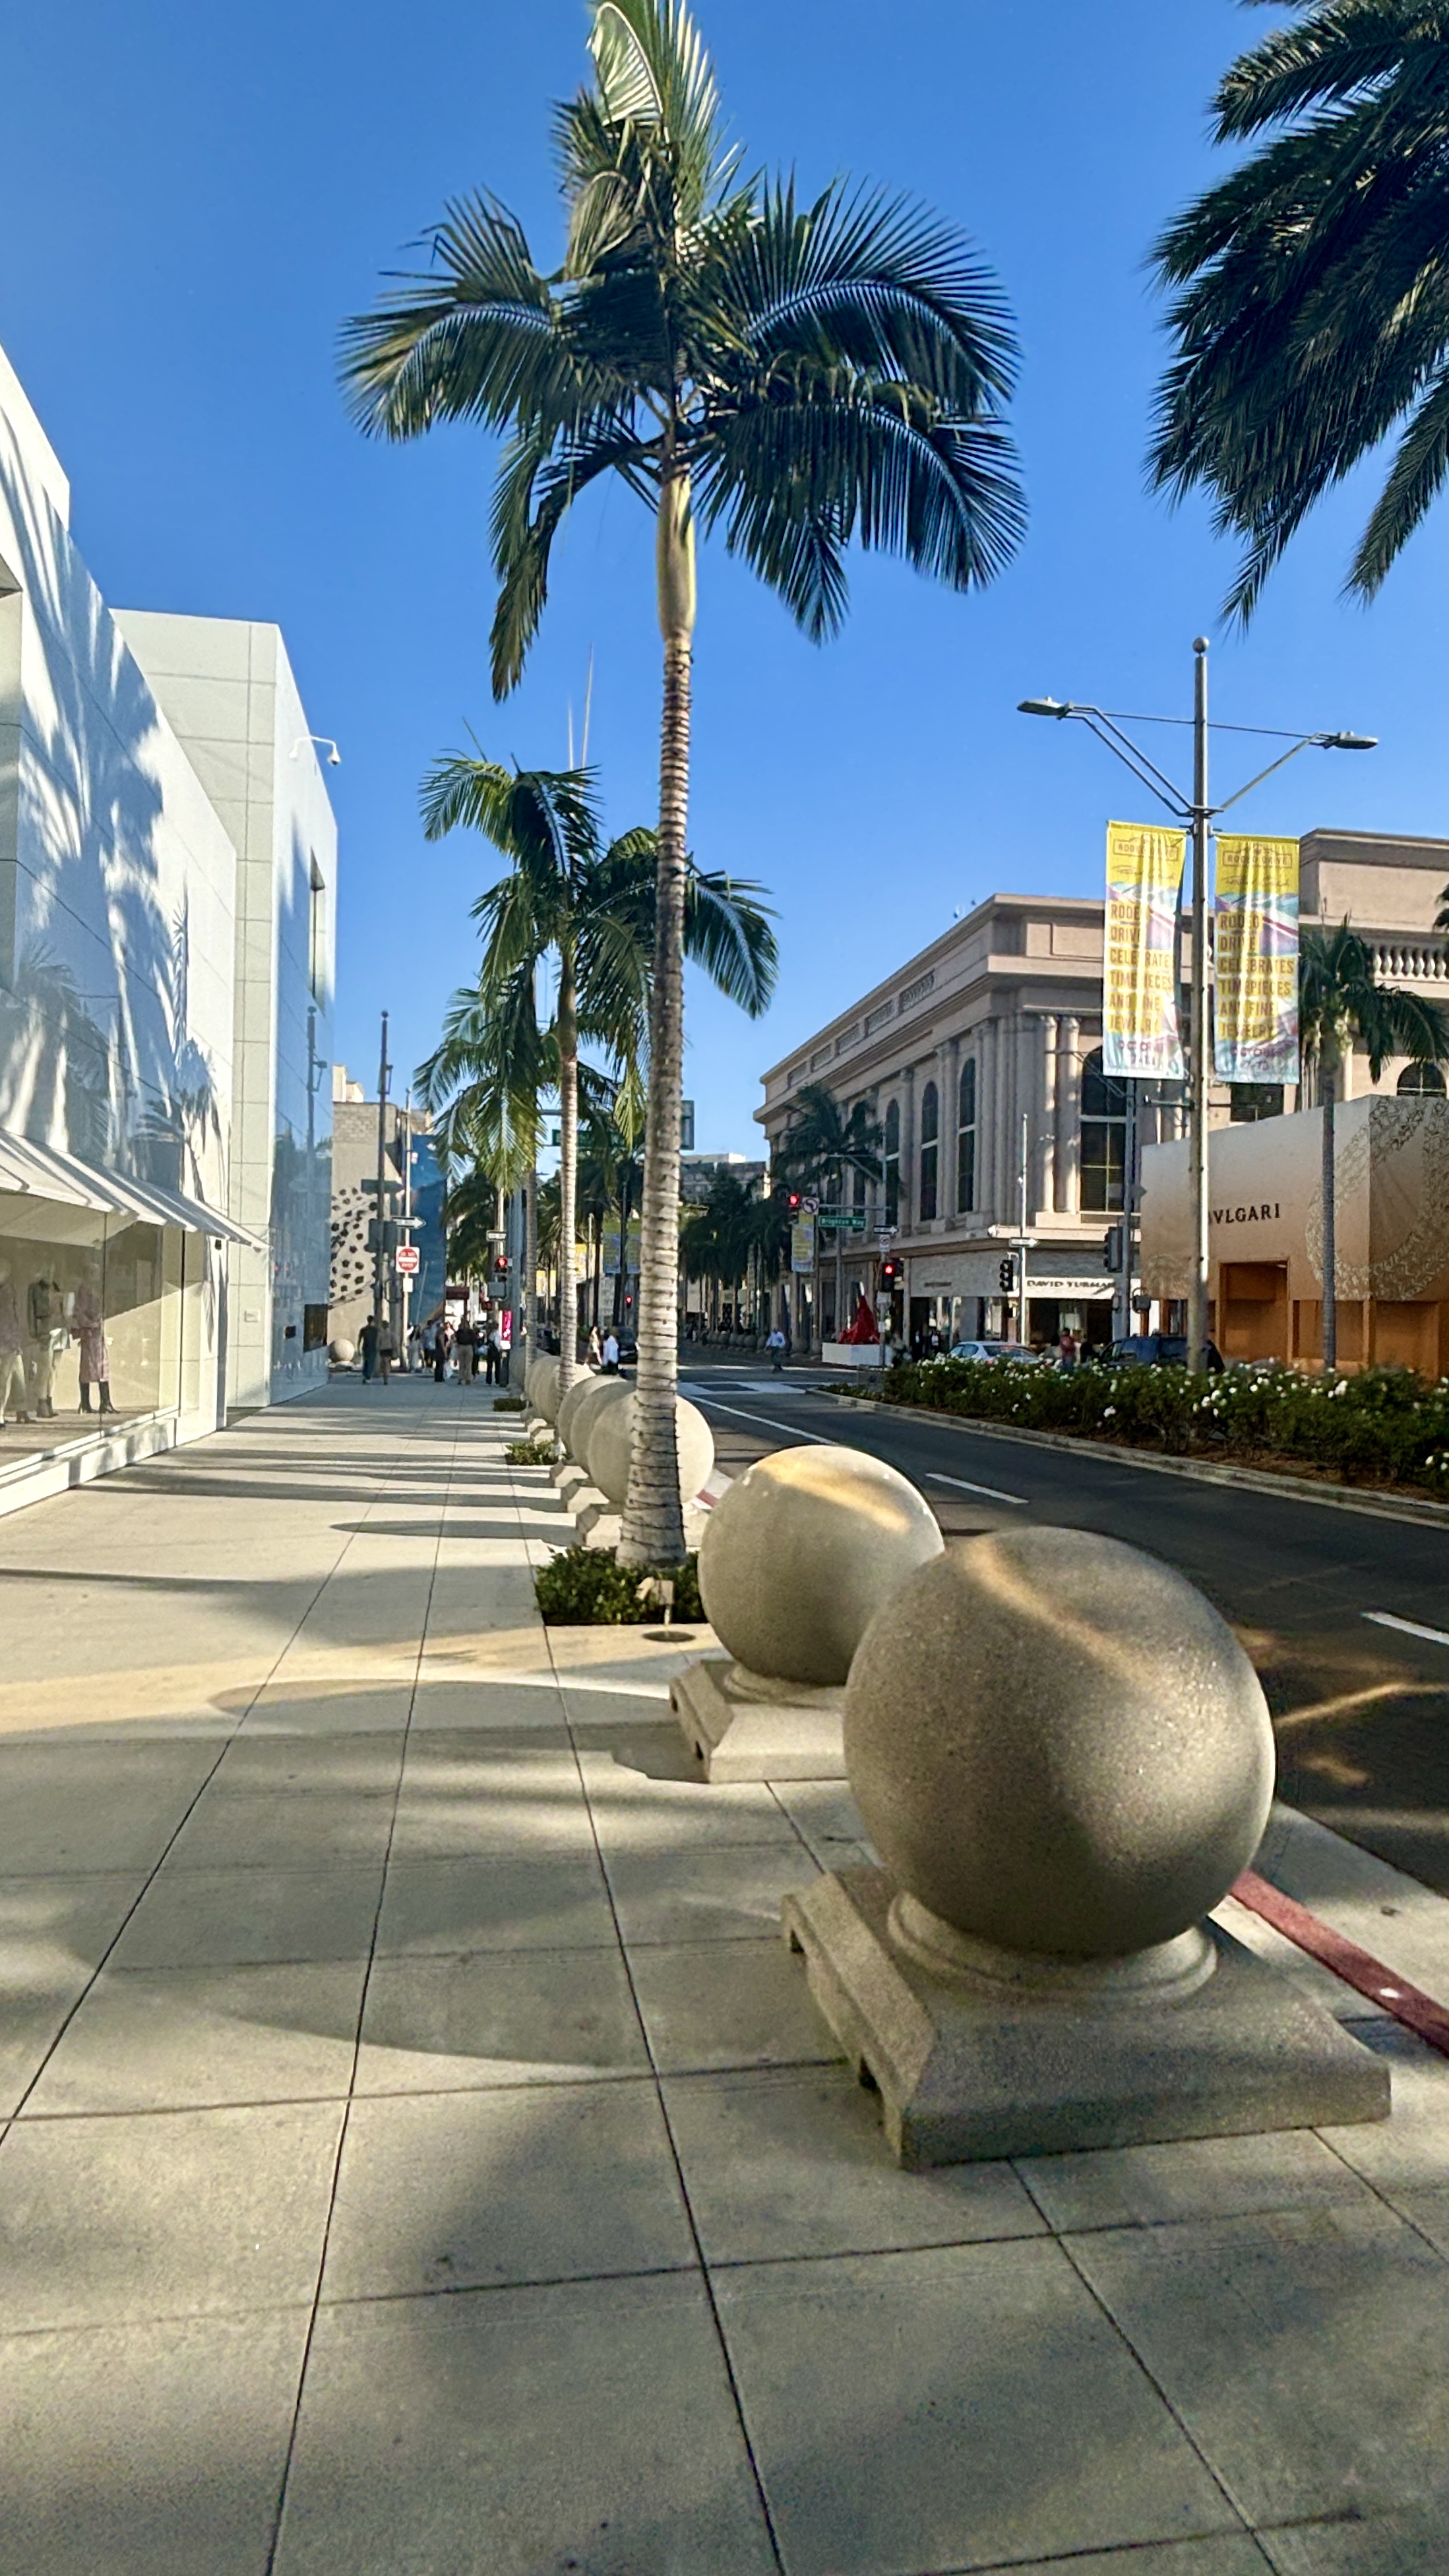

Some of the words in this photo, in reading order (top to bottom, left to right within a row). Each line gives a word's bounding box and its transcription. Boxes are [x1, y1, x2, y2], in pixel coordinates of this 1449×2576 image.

[1227, 854, 1259, 864] RODO
[1111, 903, 1145, 921] RODE
[1110, 926, 1143, 943] DRIV
[1110, 948, 1172, 968] CELERATE
[1110, 970, 1173, 990] TIMEIECES
[1139, 994, 1161, 1011] INE
[1245, 1001, 1277, 1017] FIN
[821, 1218, 849, 1226] Brighton
